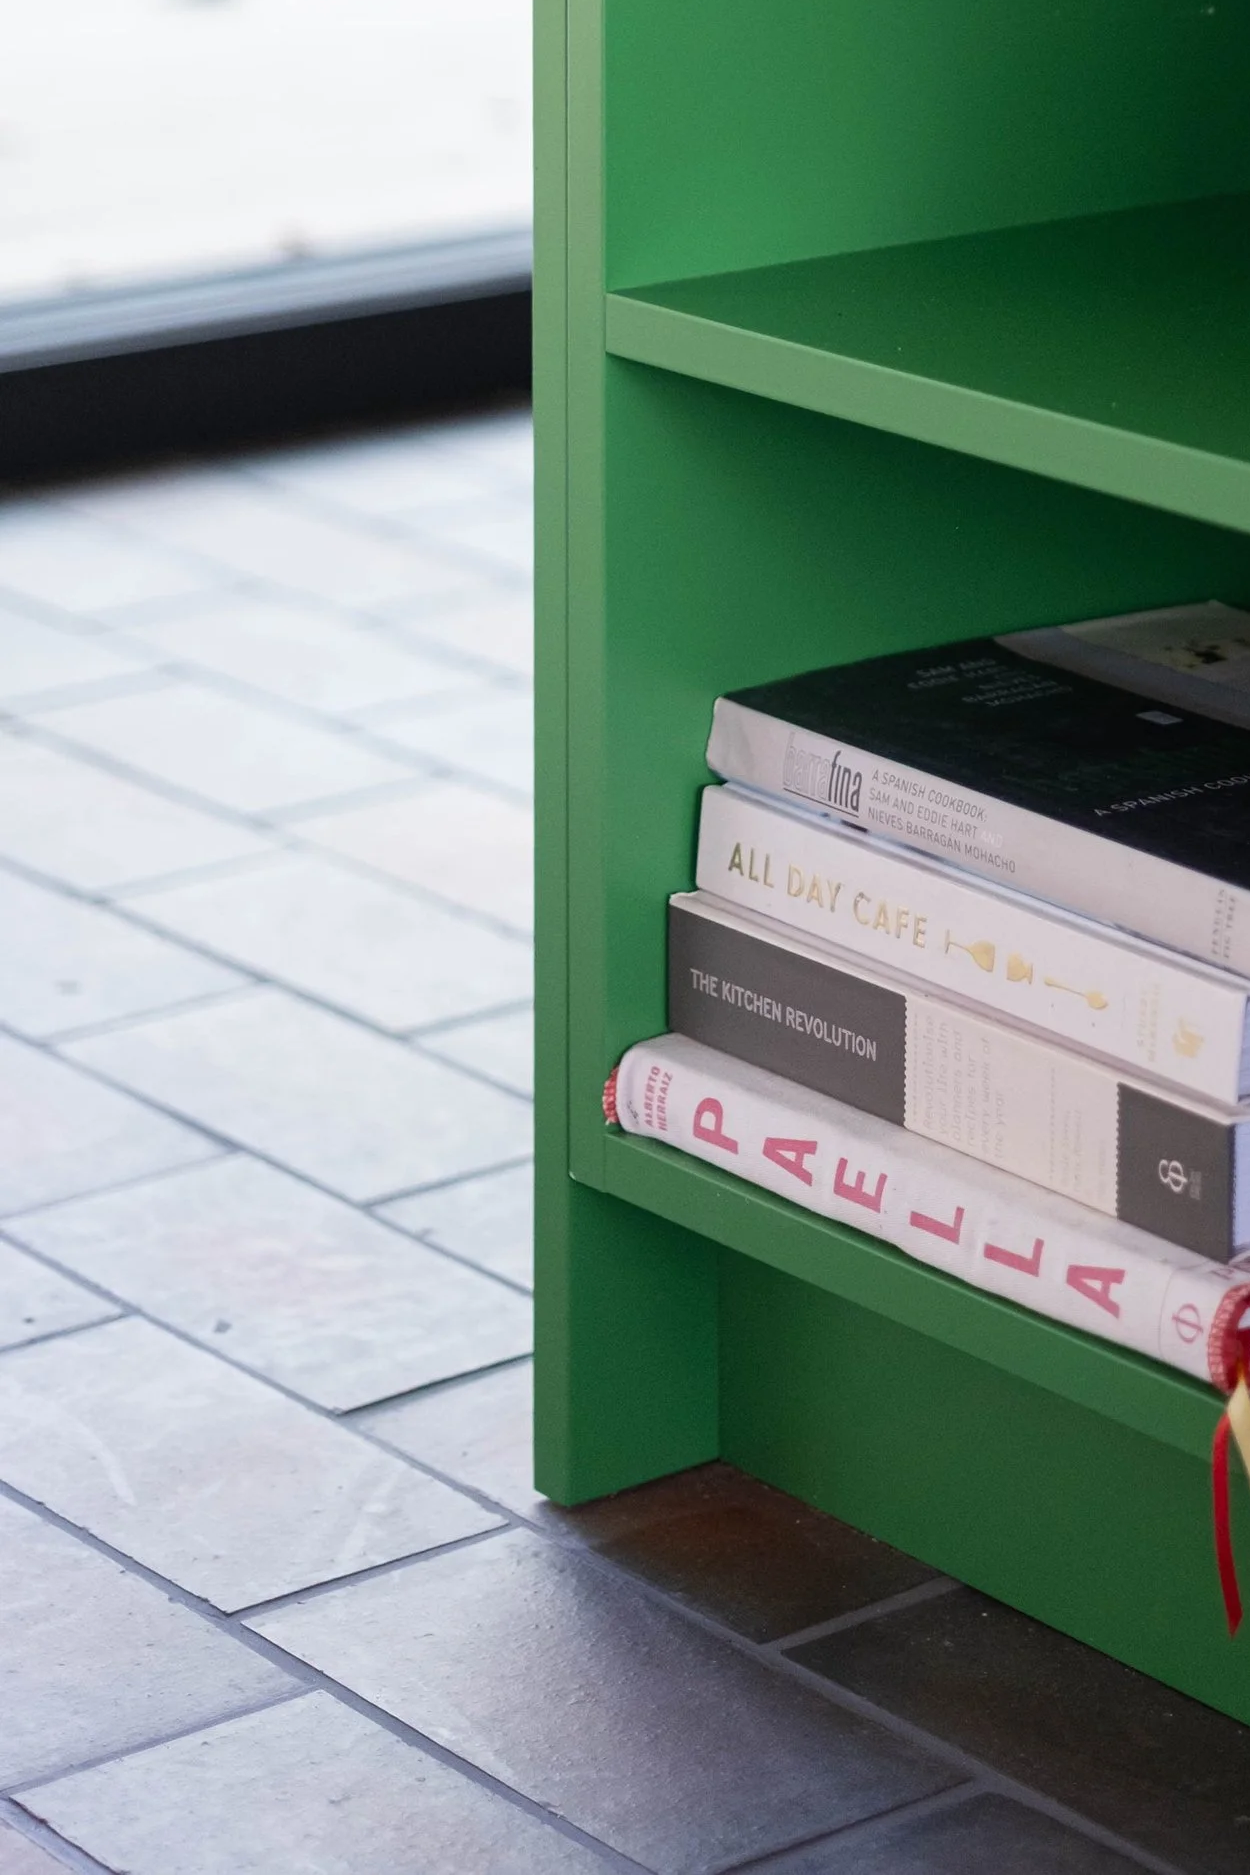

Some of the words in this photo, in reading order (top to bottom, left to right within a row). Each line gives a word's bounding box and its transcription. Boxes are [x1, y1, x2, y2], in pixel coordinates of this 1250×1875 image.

[782, 731, 863, 812] barrafina
[871, 769, 880, 782] A
[881, 772, 926, 798] SPANISH
[1093, 807, 1112, 818] A
[1109, 785, 1204, 815] SPANISH
[868, 787, 891, 806] SAM
[892, 796, 915, 815] AND
[917, 805, 948, 829] EDDIE
[950, 818, 978, 841] HART
[868, 807, 904, 832] NIEVES
[964, 843, 1016, 874] MOHACHO
[728, 842, 774, 889] ALL
[787, 864, 842, 912] DAY
[853, 892, 929, 949] CAFE
[690, 968, 719, 998] THE
[722, 980, 782, 1023] KITCHEN
[786, 1006, 877, 1062] REVOLUTION
[953, 1030, 963, 1063] and
[643, 1066, 660, 1128] ALBERTO
[656, 1072, 673, 1131] HERRAIZ
[693, 1096, 1126, 1319] PAELLA
